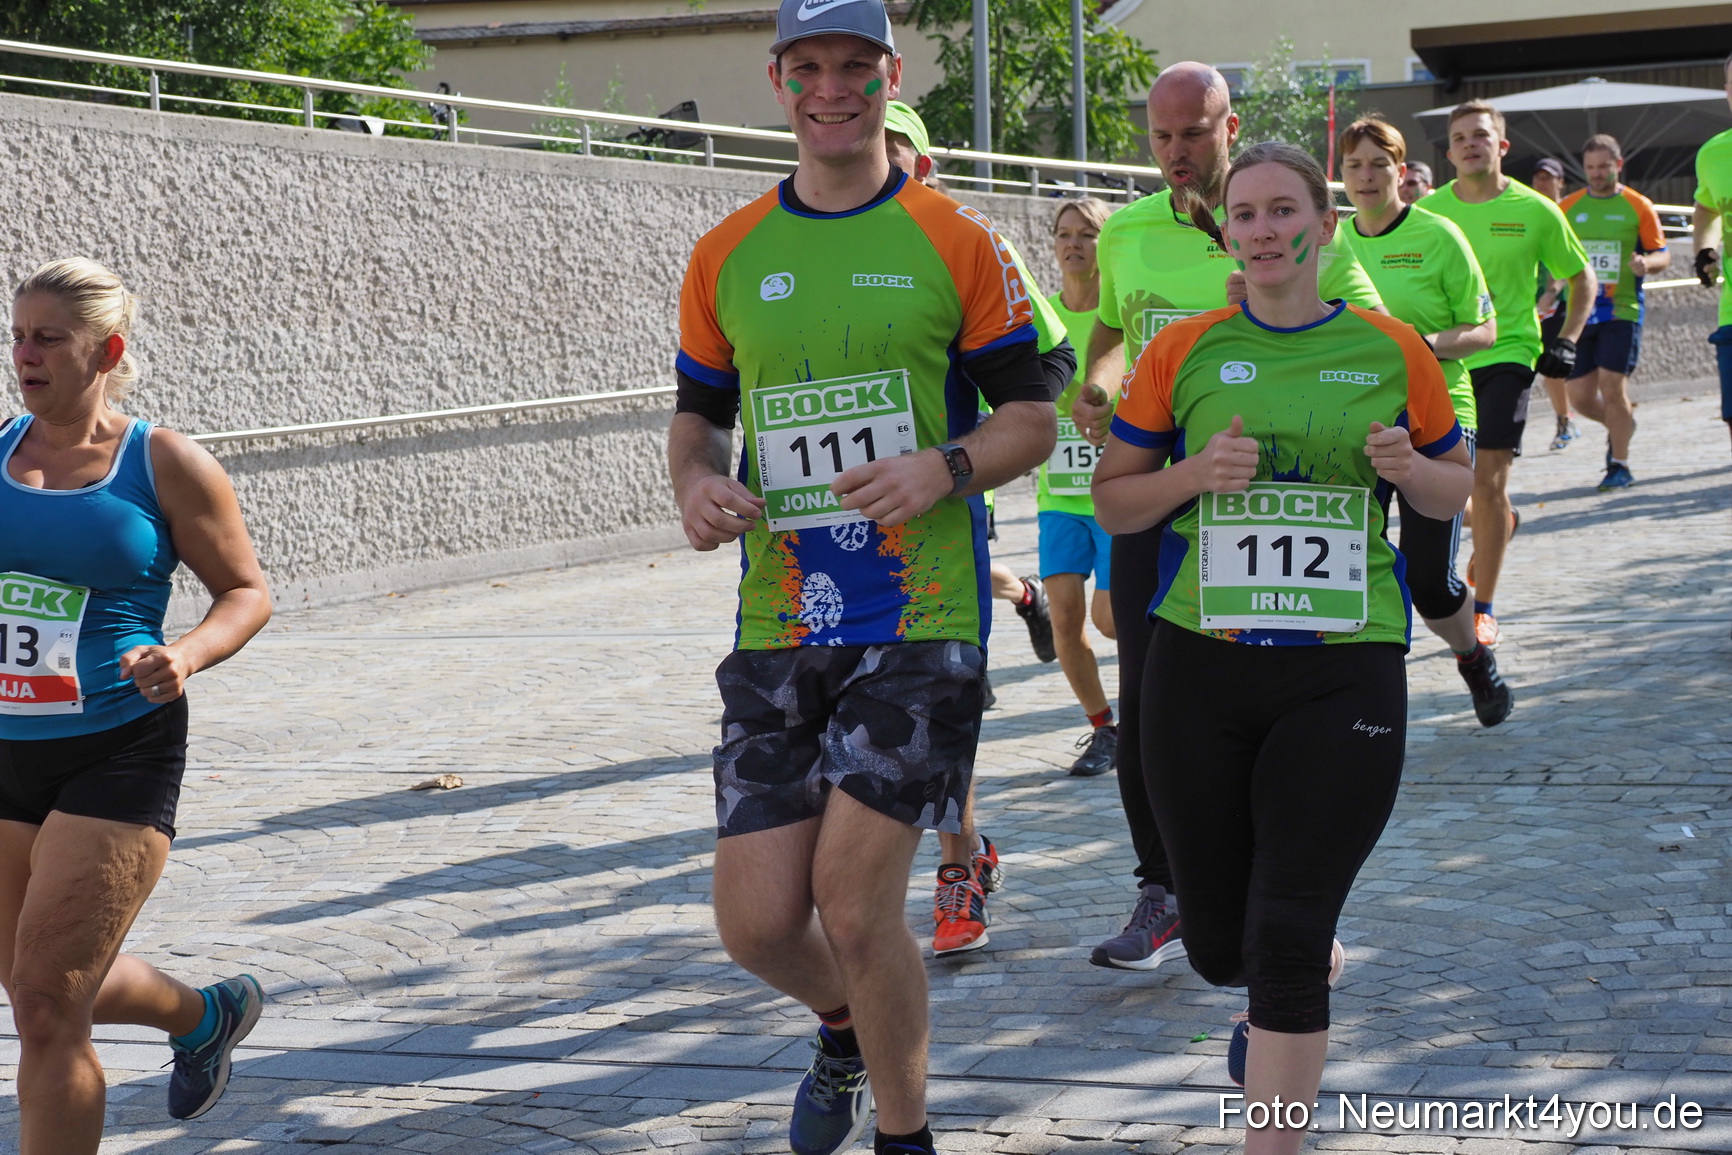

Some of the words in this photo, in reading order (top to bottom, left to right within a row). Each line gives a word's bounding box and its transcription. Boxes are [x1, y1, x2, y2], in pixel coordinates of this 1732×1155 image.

[853, 273, 914, 288] BOCK
[1320, 370, 1379, 385] BOCK
[763, 378, 897, 425] BOCK
[897, 424, 909, 433] E6
[789, 427, 876, 477] 111
[780, 490, 848, 513] JONA
[1212, 489, 1353, 525] BOCK
[1236, 535, 1330, 579] 112
[1350, 543, 1361, 551] E6
[0, 578, 72, 617] CK
[1352, 718, 1392, 738] benger
